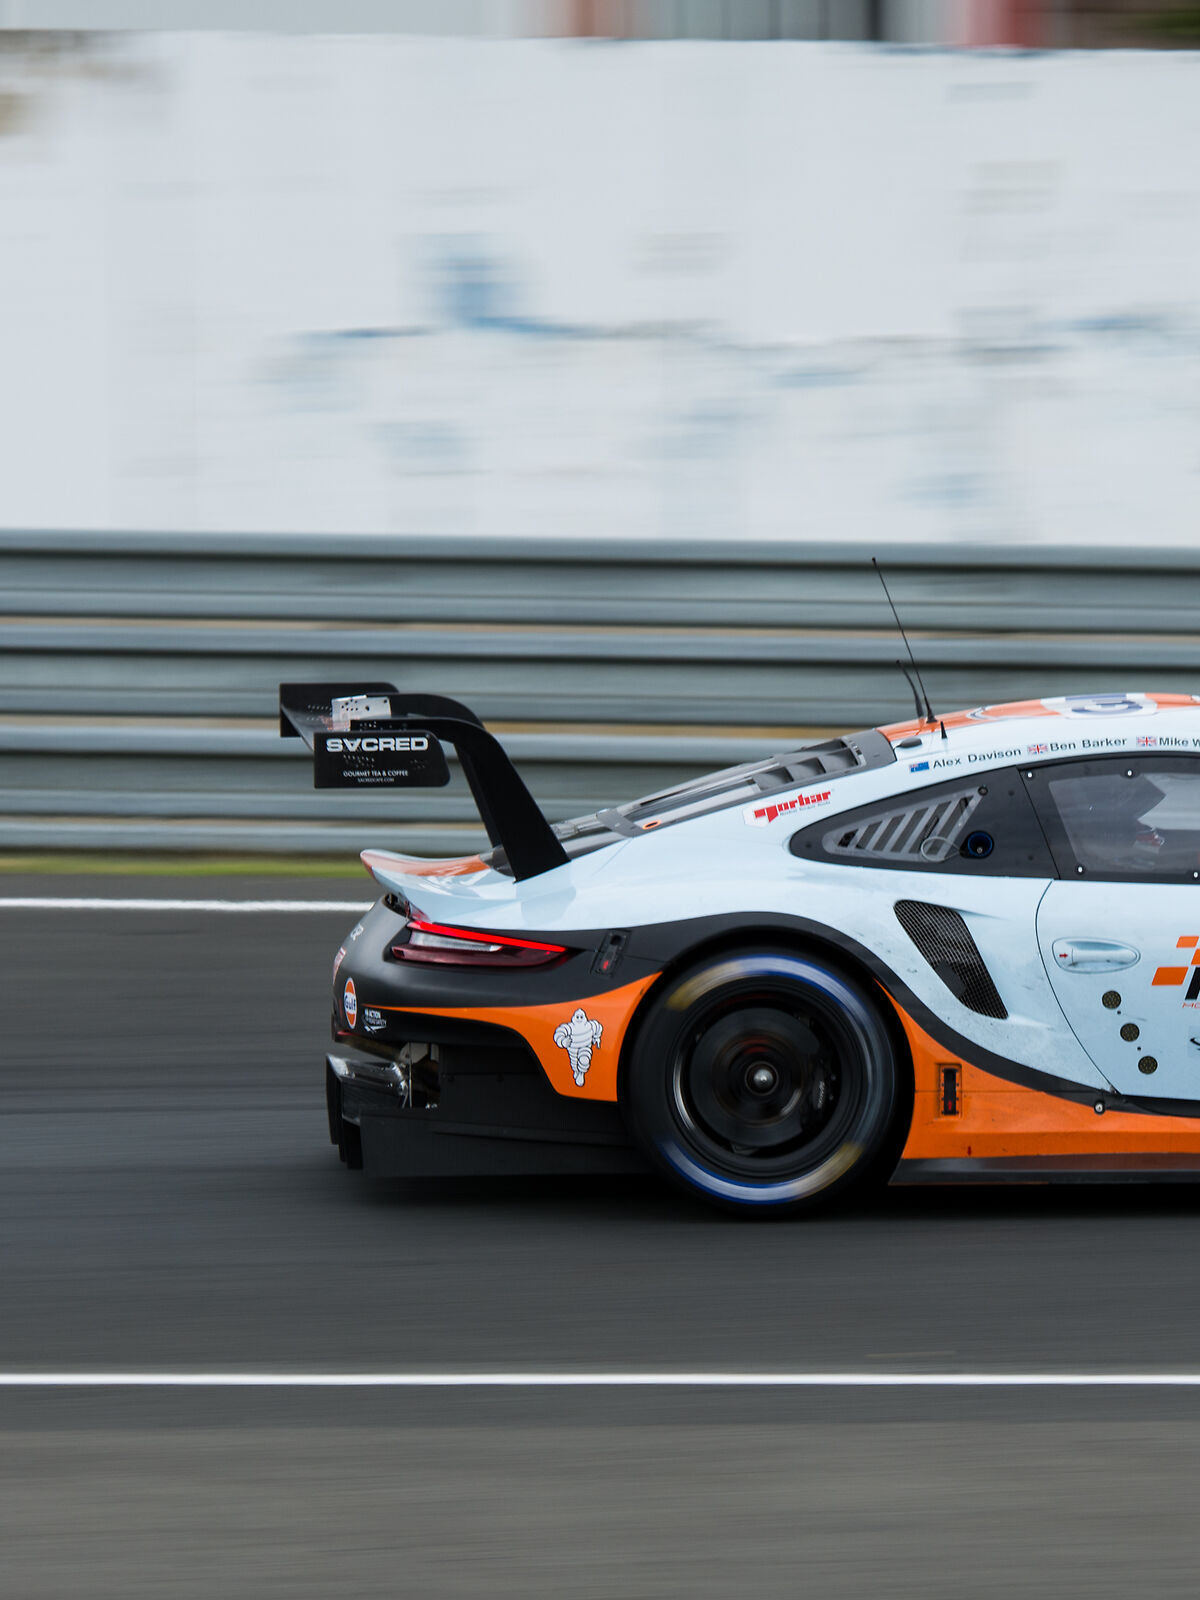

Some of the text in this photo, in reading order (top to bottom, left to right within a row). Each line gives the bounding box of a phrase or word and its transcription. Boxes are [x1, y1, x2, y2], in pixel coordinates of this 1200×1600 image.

[933, 758, 961, 769] Alex
[967, 748, 1021, 763] Davison
[1049, 742, 1076, 751] Ben
[1082, 738, 1127, 748] Barker
[1159, 737, 1189, 746] Mike
